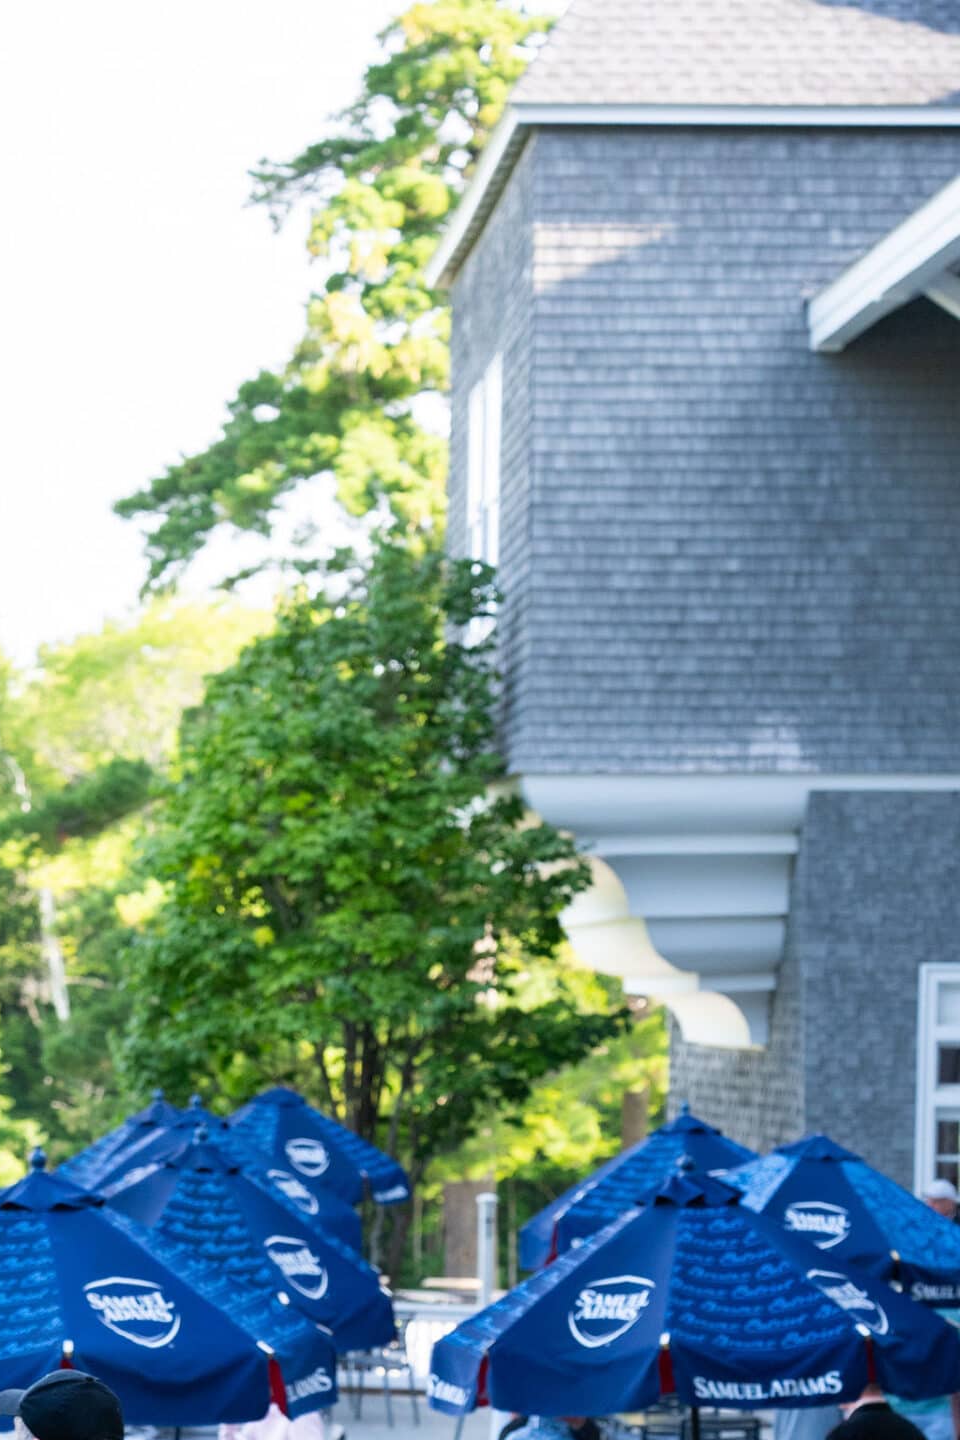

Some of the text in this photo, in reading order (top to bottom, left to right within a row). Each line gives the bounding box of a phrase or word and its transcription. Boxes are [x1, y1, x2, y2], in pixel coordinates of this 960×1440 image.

[86, 1291, 175, 1312] SAMUEL
[575, 1289, 649, 1309] SAMUEL
[693, 1370, 843, 1400] SAMUEL ADAMS
